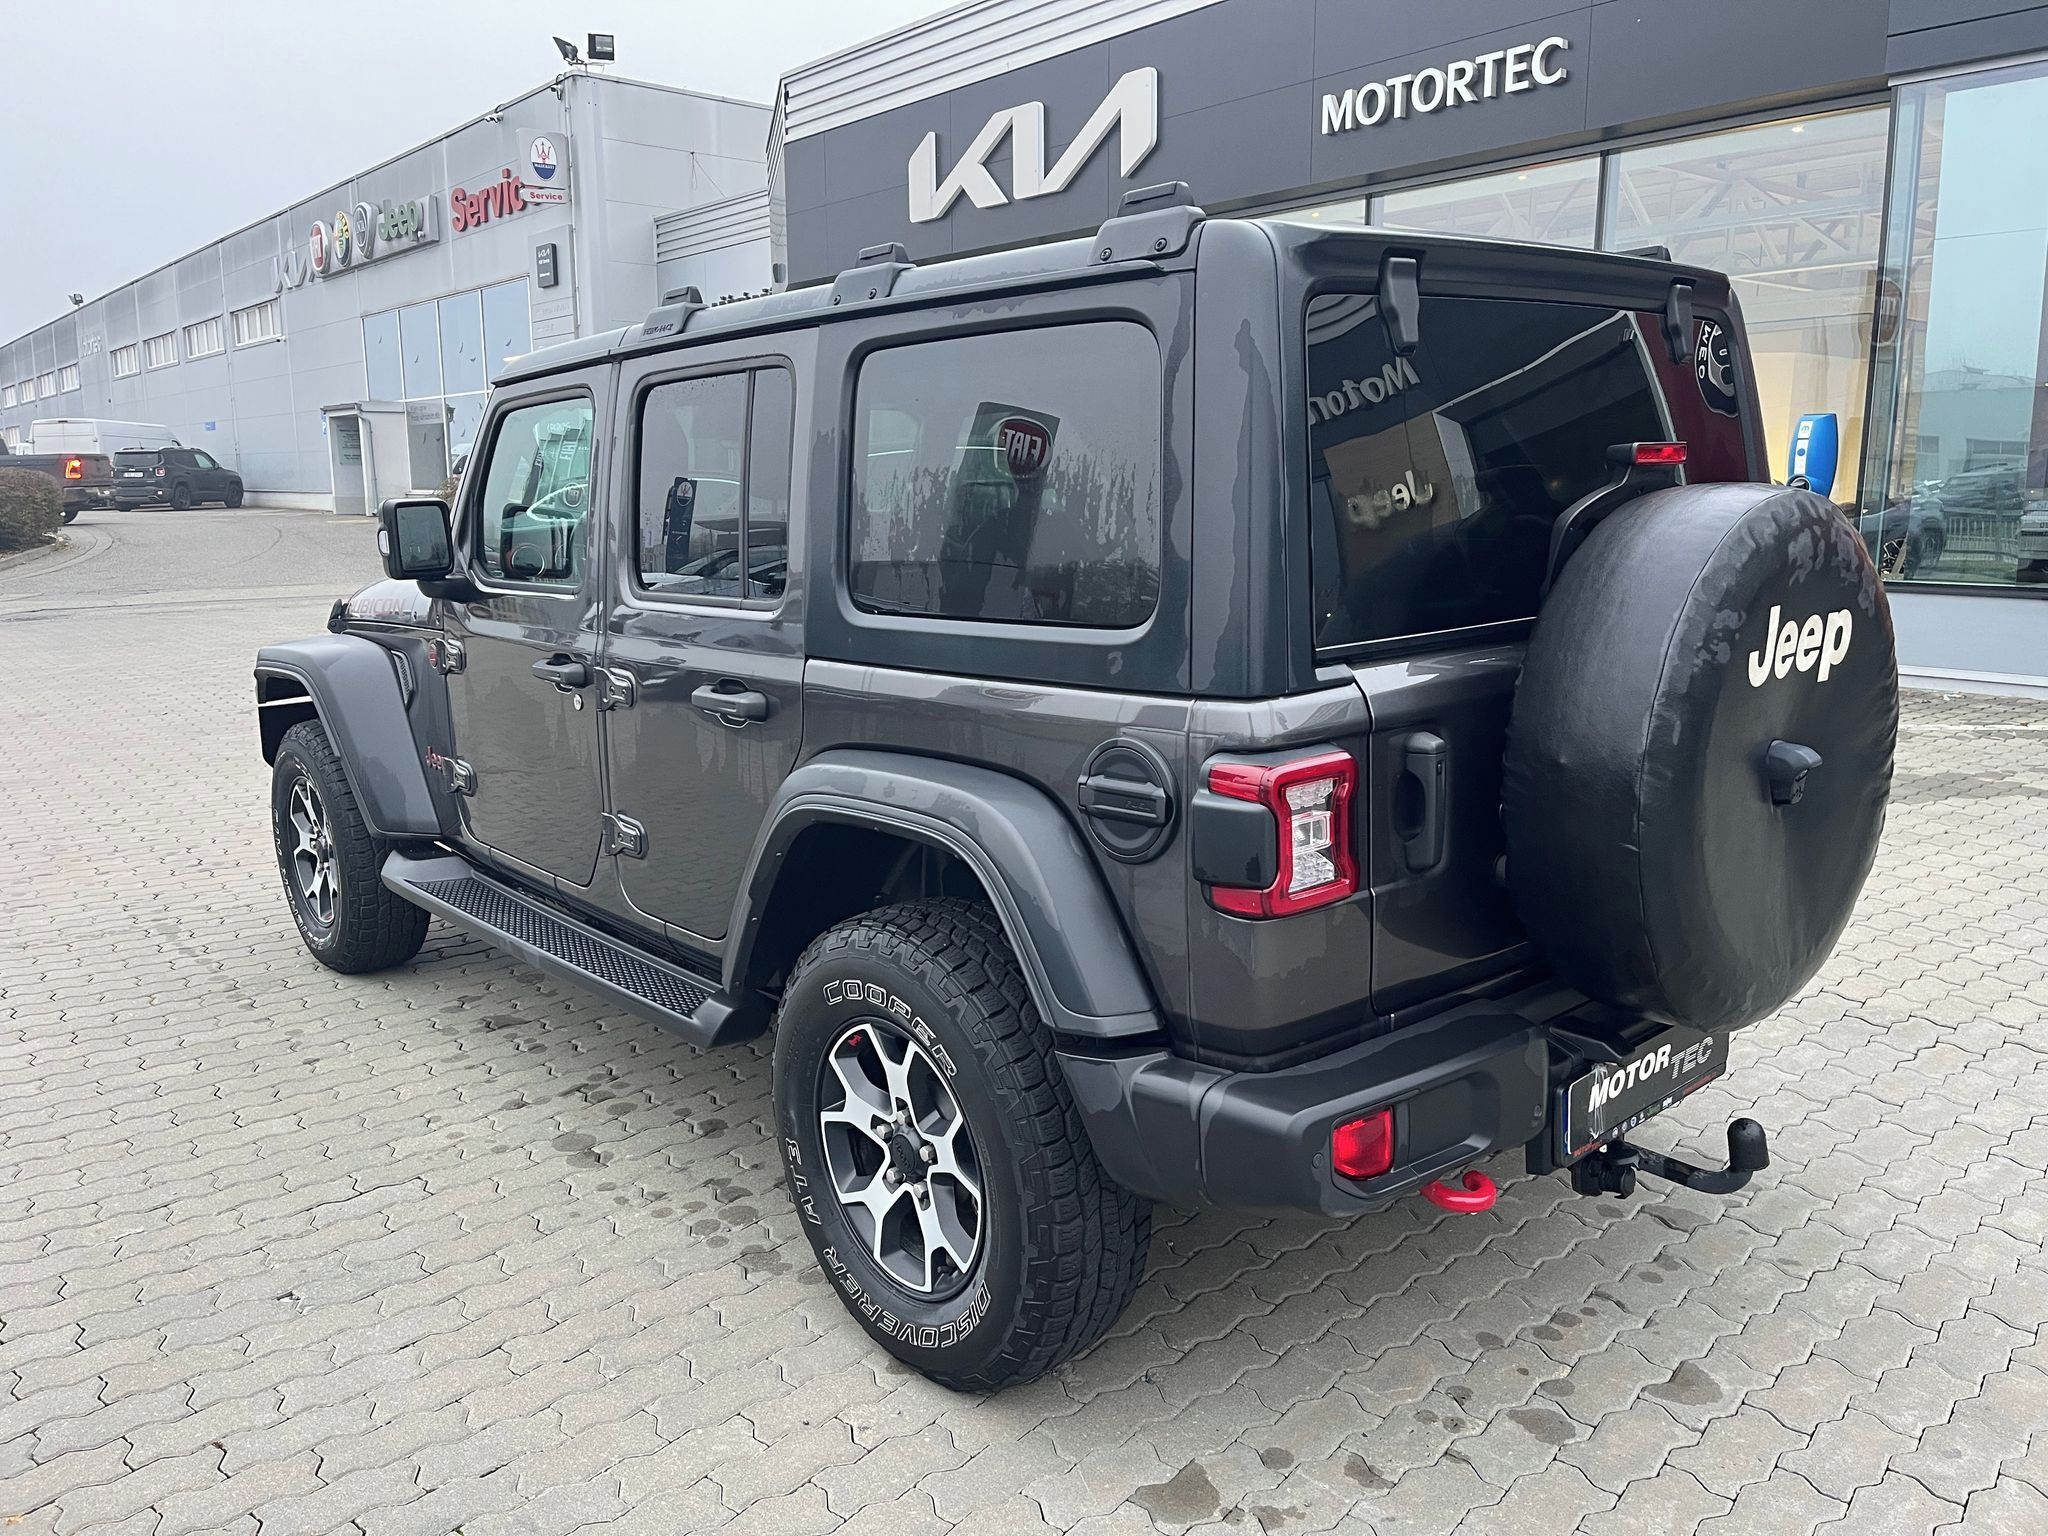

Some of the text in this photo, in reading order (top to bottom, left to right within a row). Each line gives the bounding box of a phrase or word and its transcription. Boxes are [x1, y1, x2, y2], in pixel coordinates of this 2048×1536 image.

[1322, 36, 1567, 136] MOTORTEC
[908, 66, 1158, 222] KIA
[378, 200, 422, 241] Jeep
[451, 168, 530, 232] Servic
[530, 191, 563, 201] Service
[1747, 603, 1853, 689] Jeep
[425, 745, 444, 770] Jee
[823, 979, 958, 1078] COOPER
[823, 1245, 993, 1349] DISCOVERER
